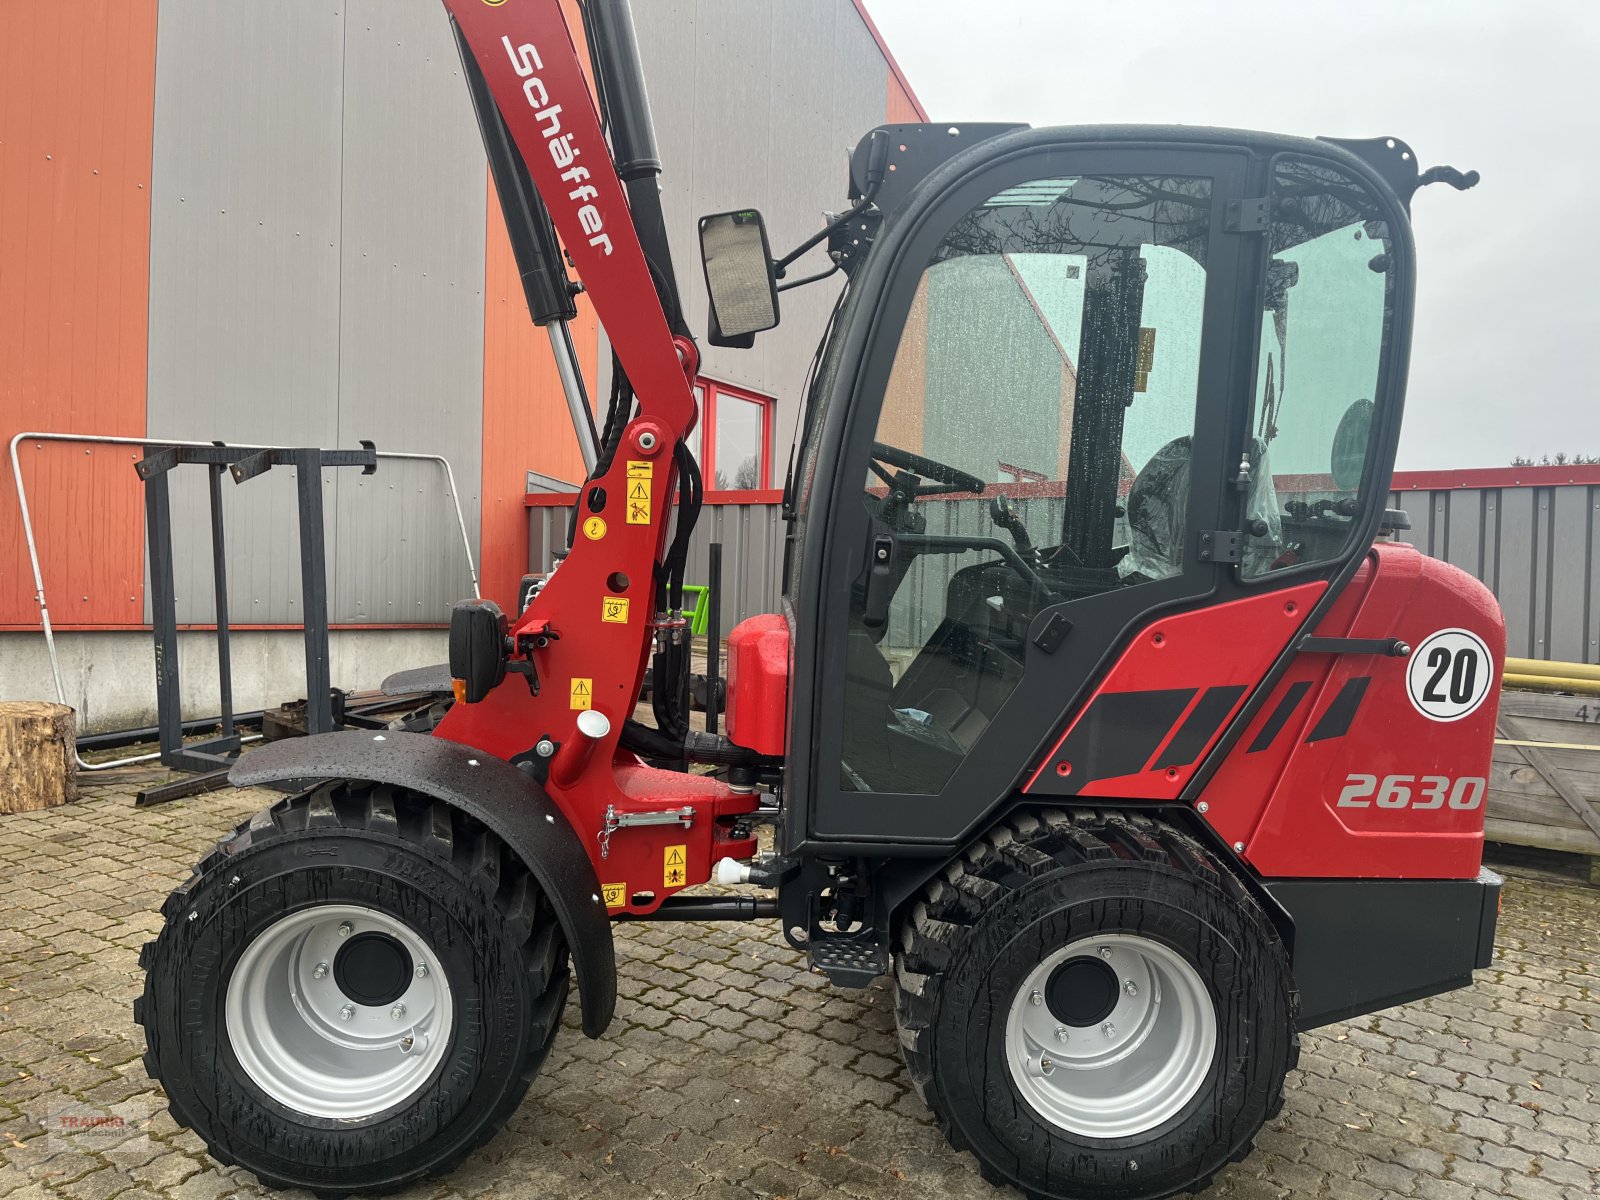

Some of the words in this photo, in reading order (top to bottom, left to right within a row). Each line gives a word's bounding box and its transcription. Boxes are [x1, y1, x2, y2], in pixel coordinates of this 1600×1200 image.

[501, 35, 613, 256] Schäffer
[1423, 647, 1478, 704] 20
[1337, 773, 1485, 809] 2630
